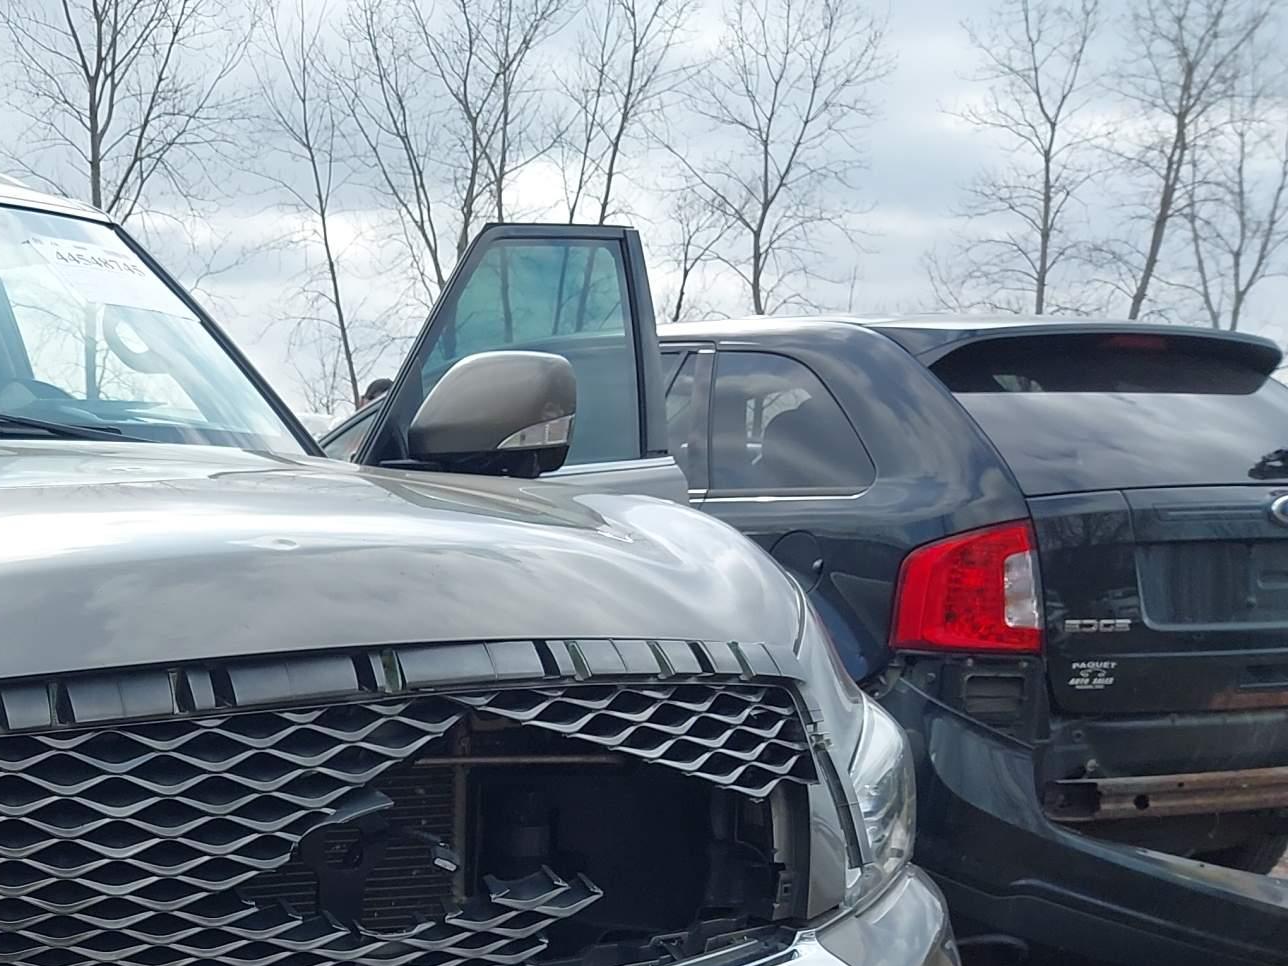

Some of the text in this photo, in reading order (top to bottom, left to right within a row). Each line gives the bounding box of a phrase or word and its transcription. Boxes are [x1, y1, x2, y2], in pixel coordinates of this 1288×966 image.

[55, 251, 145, 276] 44548745
[1064, 619, 1132, 632] EDGE
[1071, 661, 1117, 670] PAQUET
